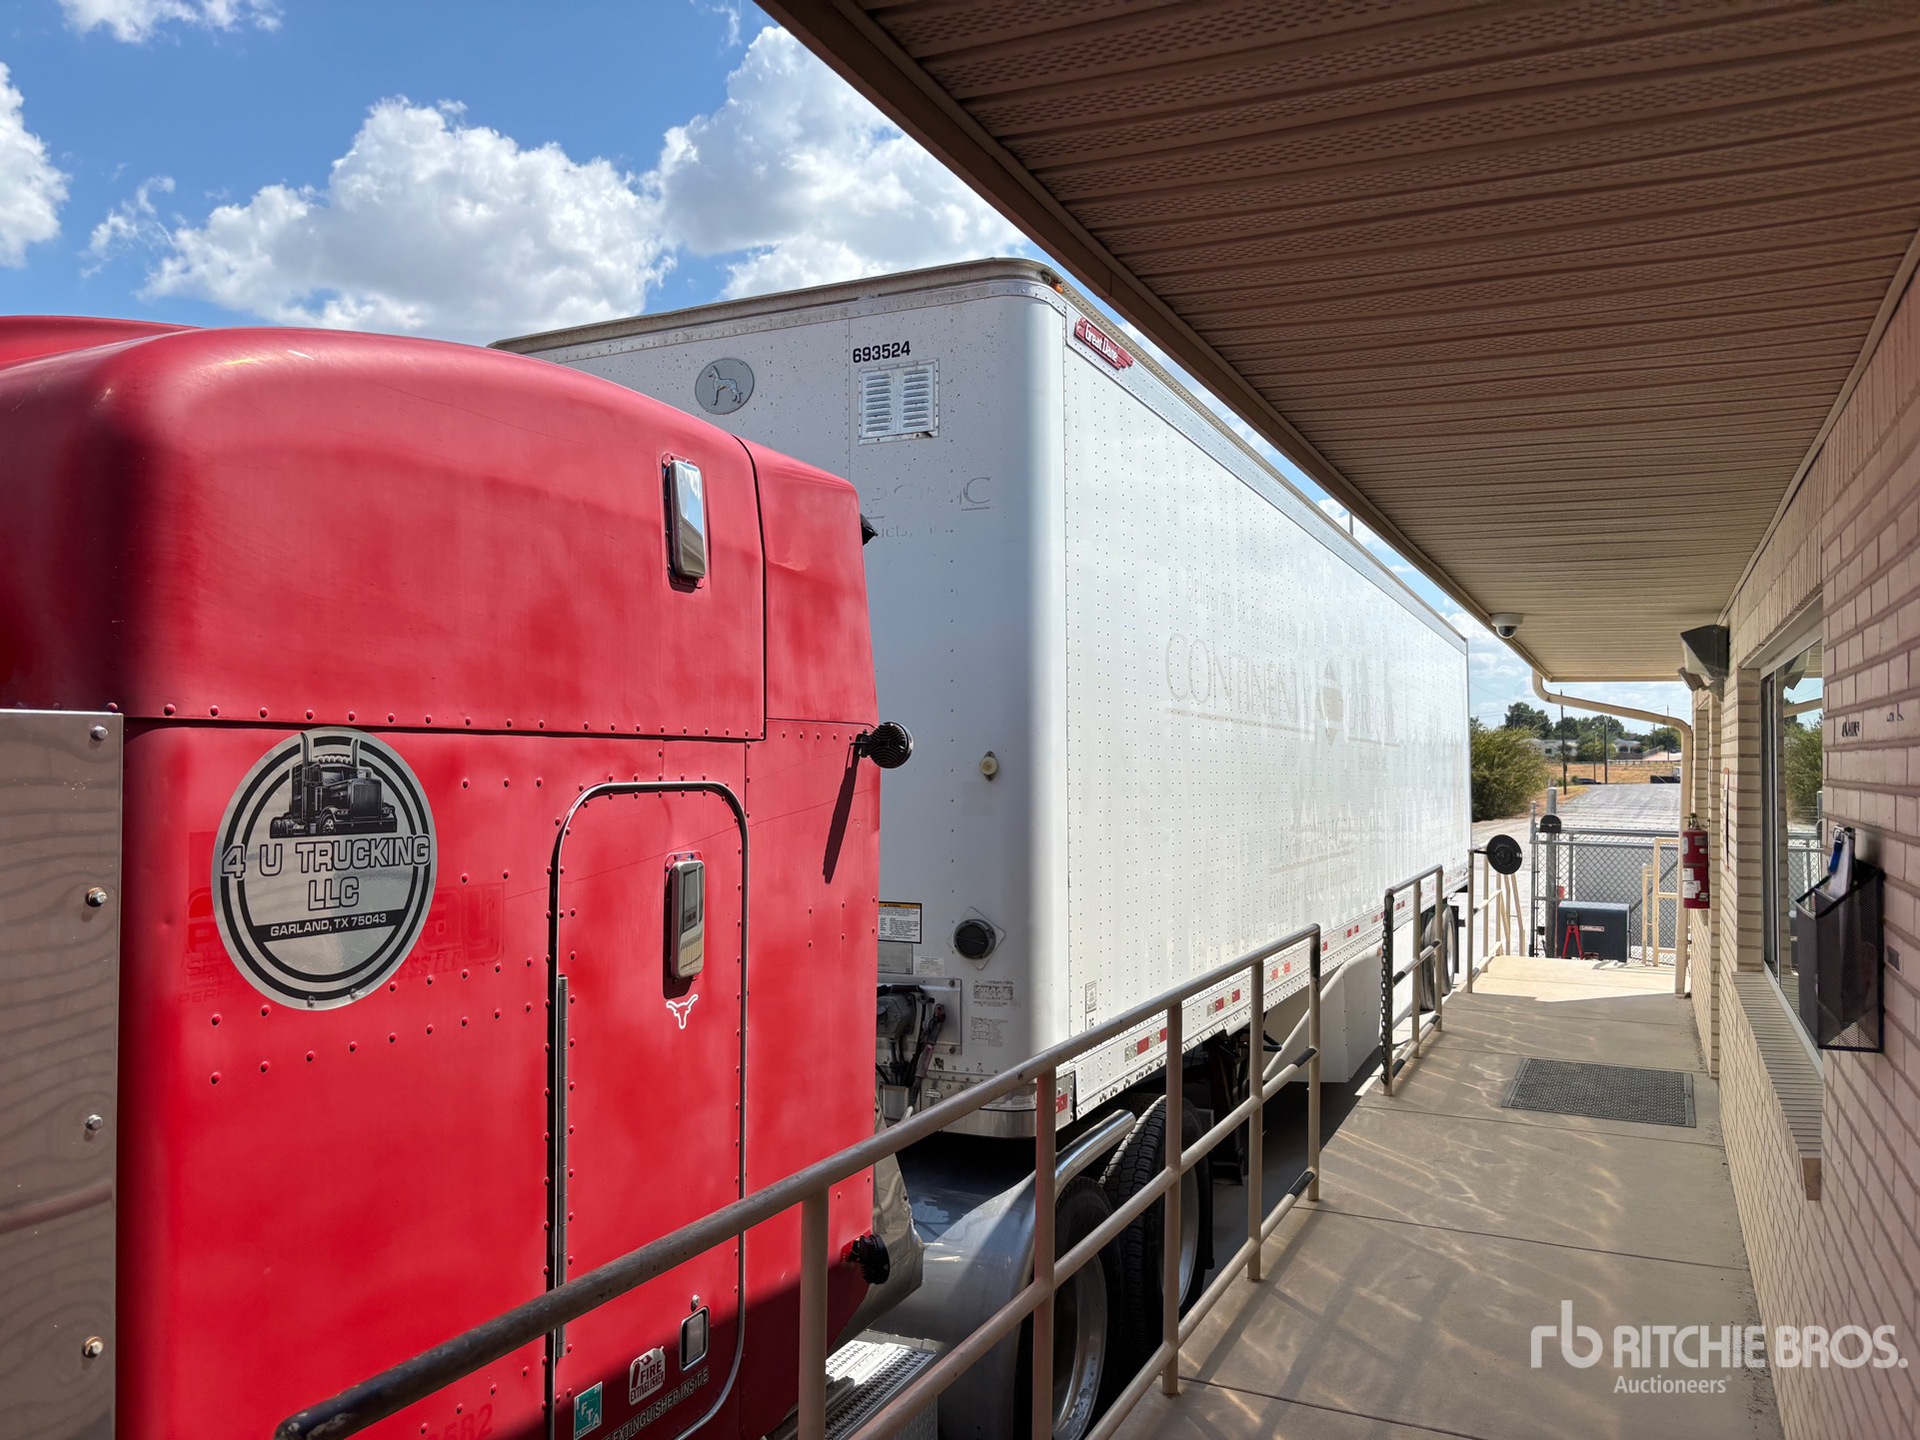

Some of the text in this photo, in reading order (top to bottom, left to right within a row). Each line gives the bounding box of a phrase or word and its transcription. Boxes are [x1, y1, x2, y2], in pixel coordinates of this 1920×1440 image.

[852, 340, 911, 363] 693524
[221, 834, 431, 880] 4 U TRUCKING
[307, 876, 360, 912] LLC
[270, 912, 388, 938] GARLAND, TX 75043
[640, 1360, 664, 1384] FIRE
[611, 1368, 710, 1440] EXTINGUISHER INSIDE
